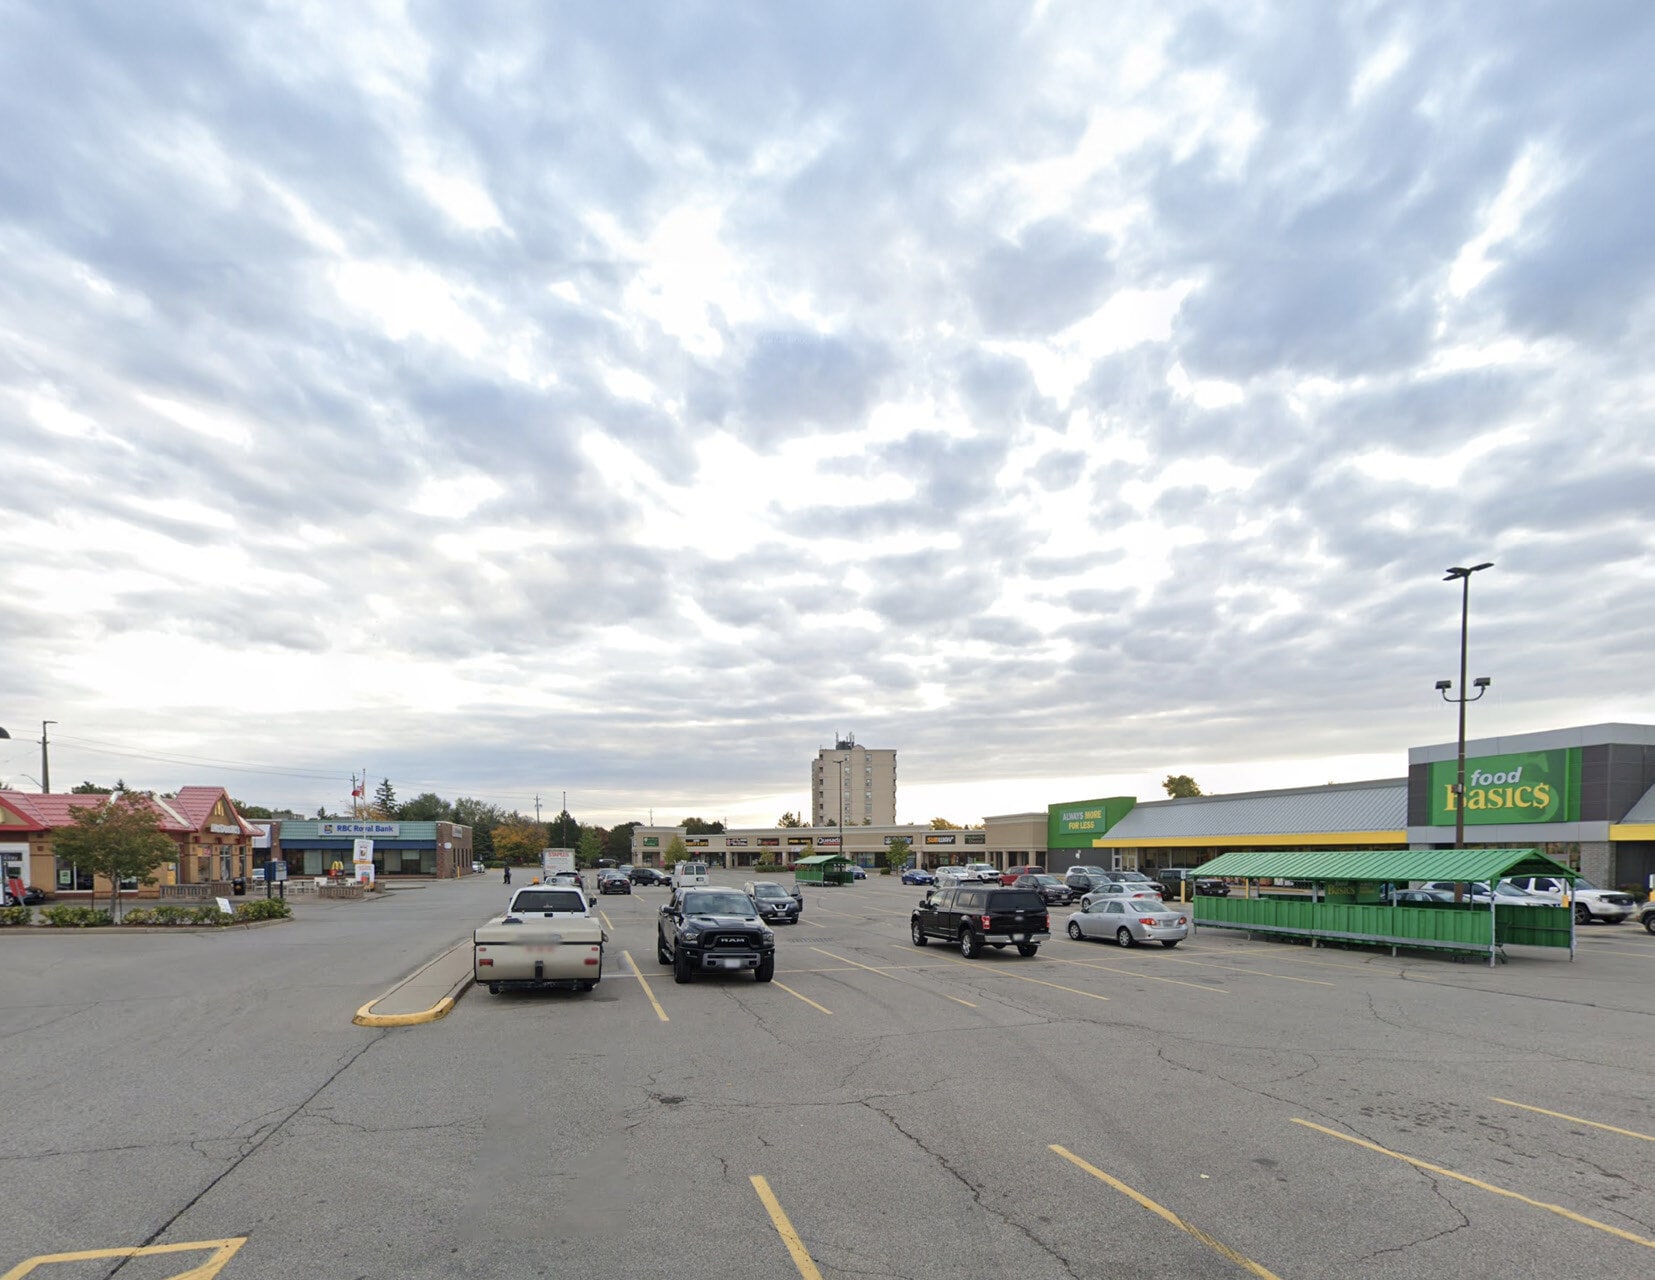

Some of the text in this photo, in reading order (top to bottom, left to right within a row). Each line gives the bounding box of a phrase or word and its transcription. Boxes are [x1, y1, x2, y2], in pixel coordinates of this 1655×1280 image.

[1471, 766, 1523, 786] food
[1063, 810, 1102, 820] ALWAYS MORE
[336, 825, 352, 833] RBC
[375, 825, 394, 833] Bank
[1068, 821, 1094, 830] FOR LESS
[926, 836, 955, 844] SUBWAY
